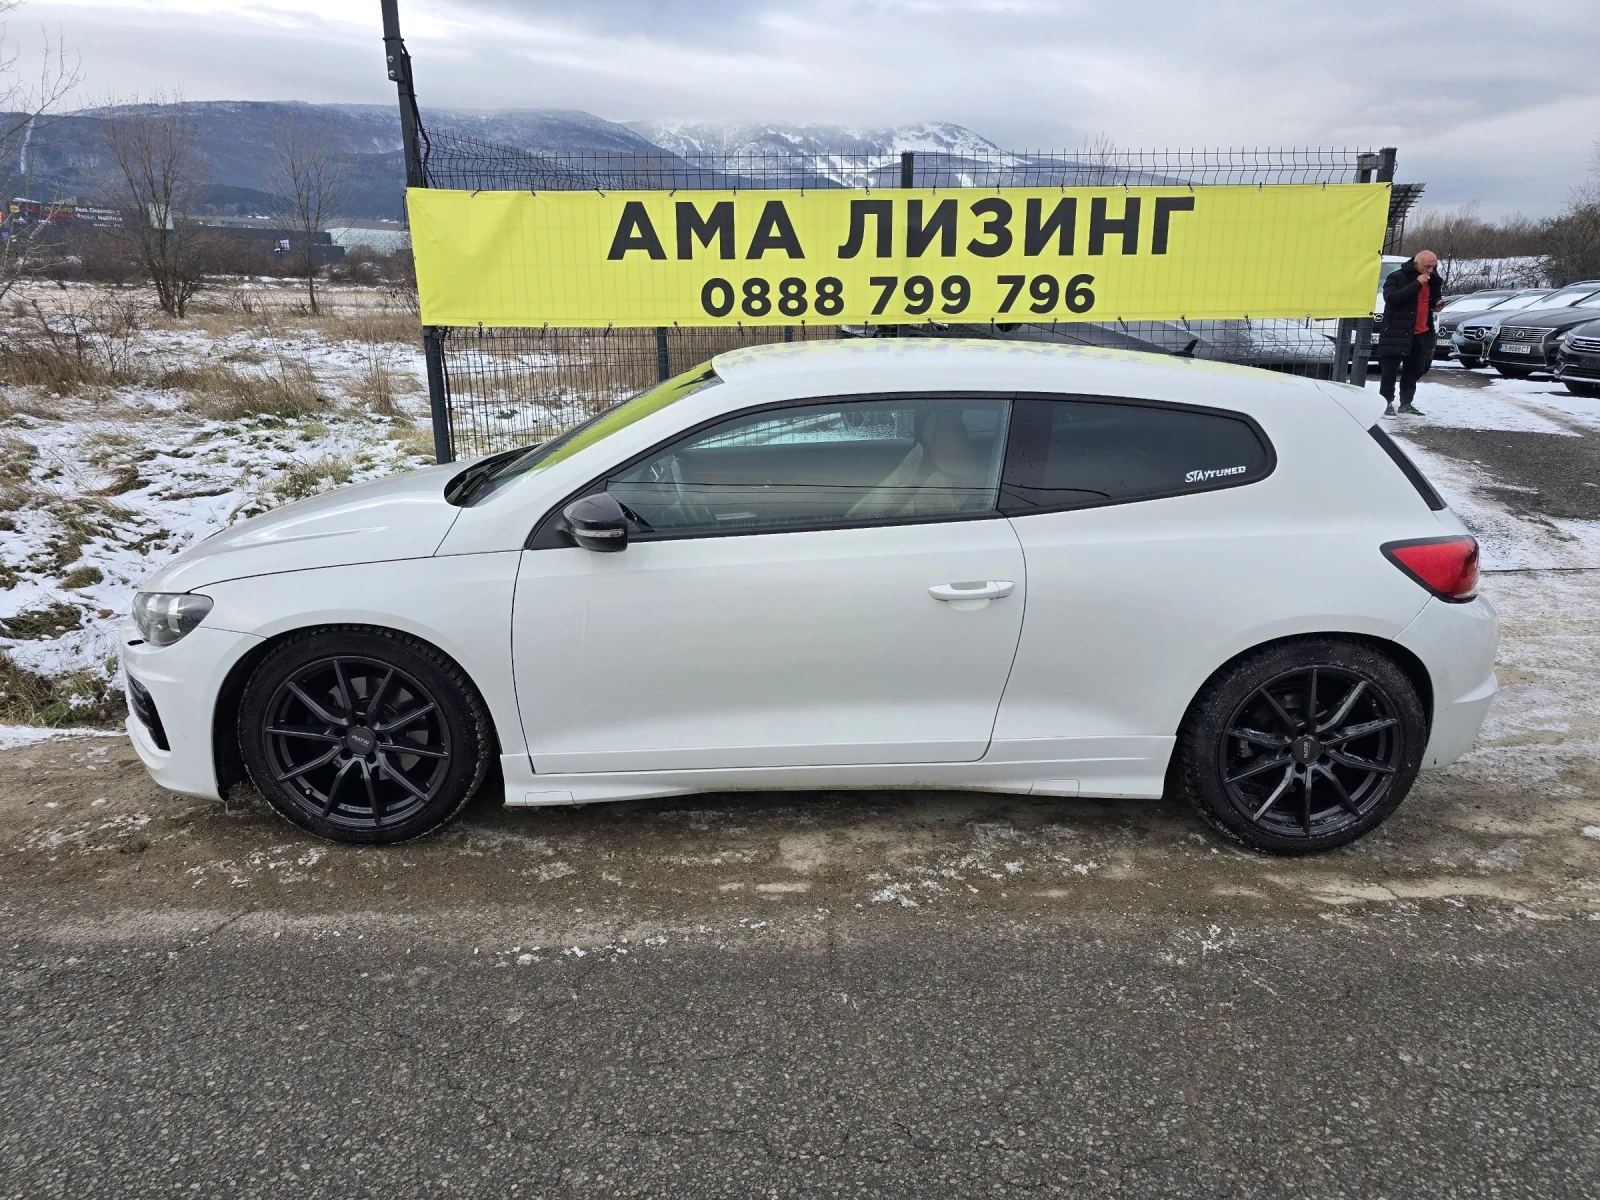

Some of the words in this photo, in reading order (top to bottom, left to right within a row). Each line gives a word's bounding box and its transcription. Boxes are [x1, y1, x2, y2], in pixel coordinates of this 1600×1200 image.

[606, 199, 806, 260] АМА
[837, 196, 1196, 260] ЛИЗИНГ
[700, 276, 845, 318] 0888
[869, 274, 971, 316] 799
[997, 273, 1095, 314] 796
